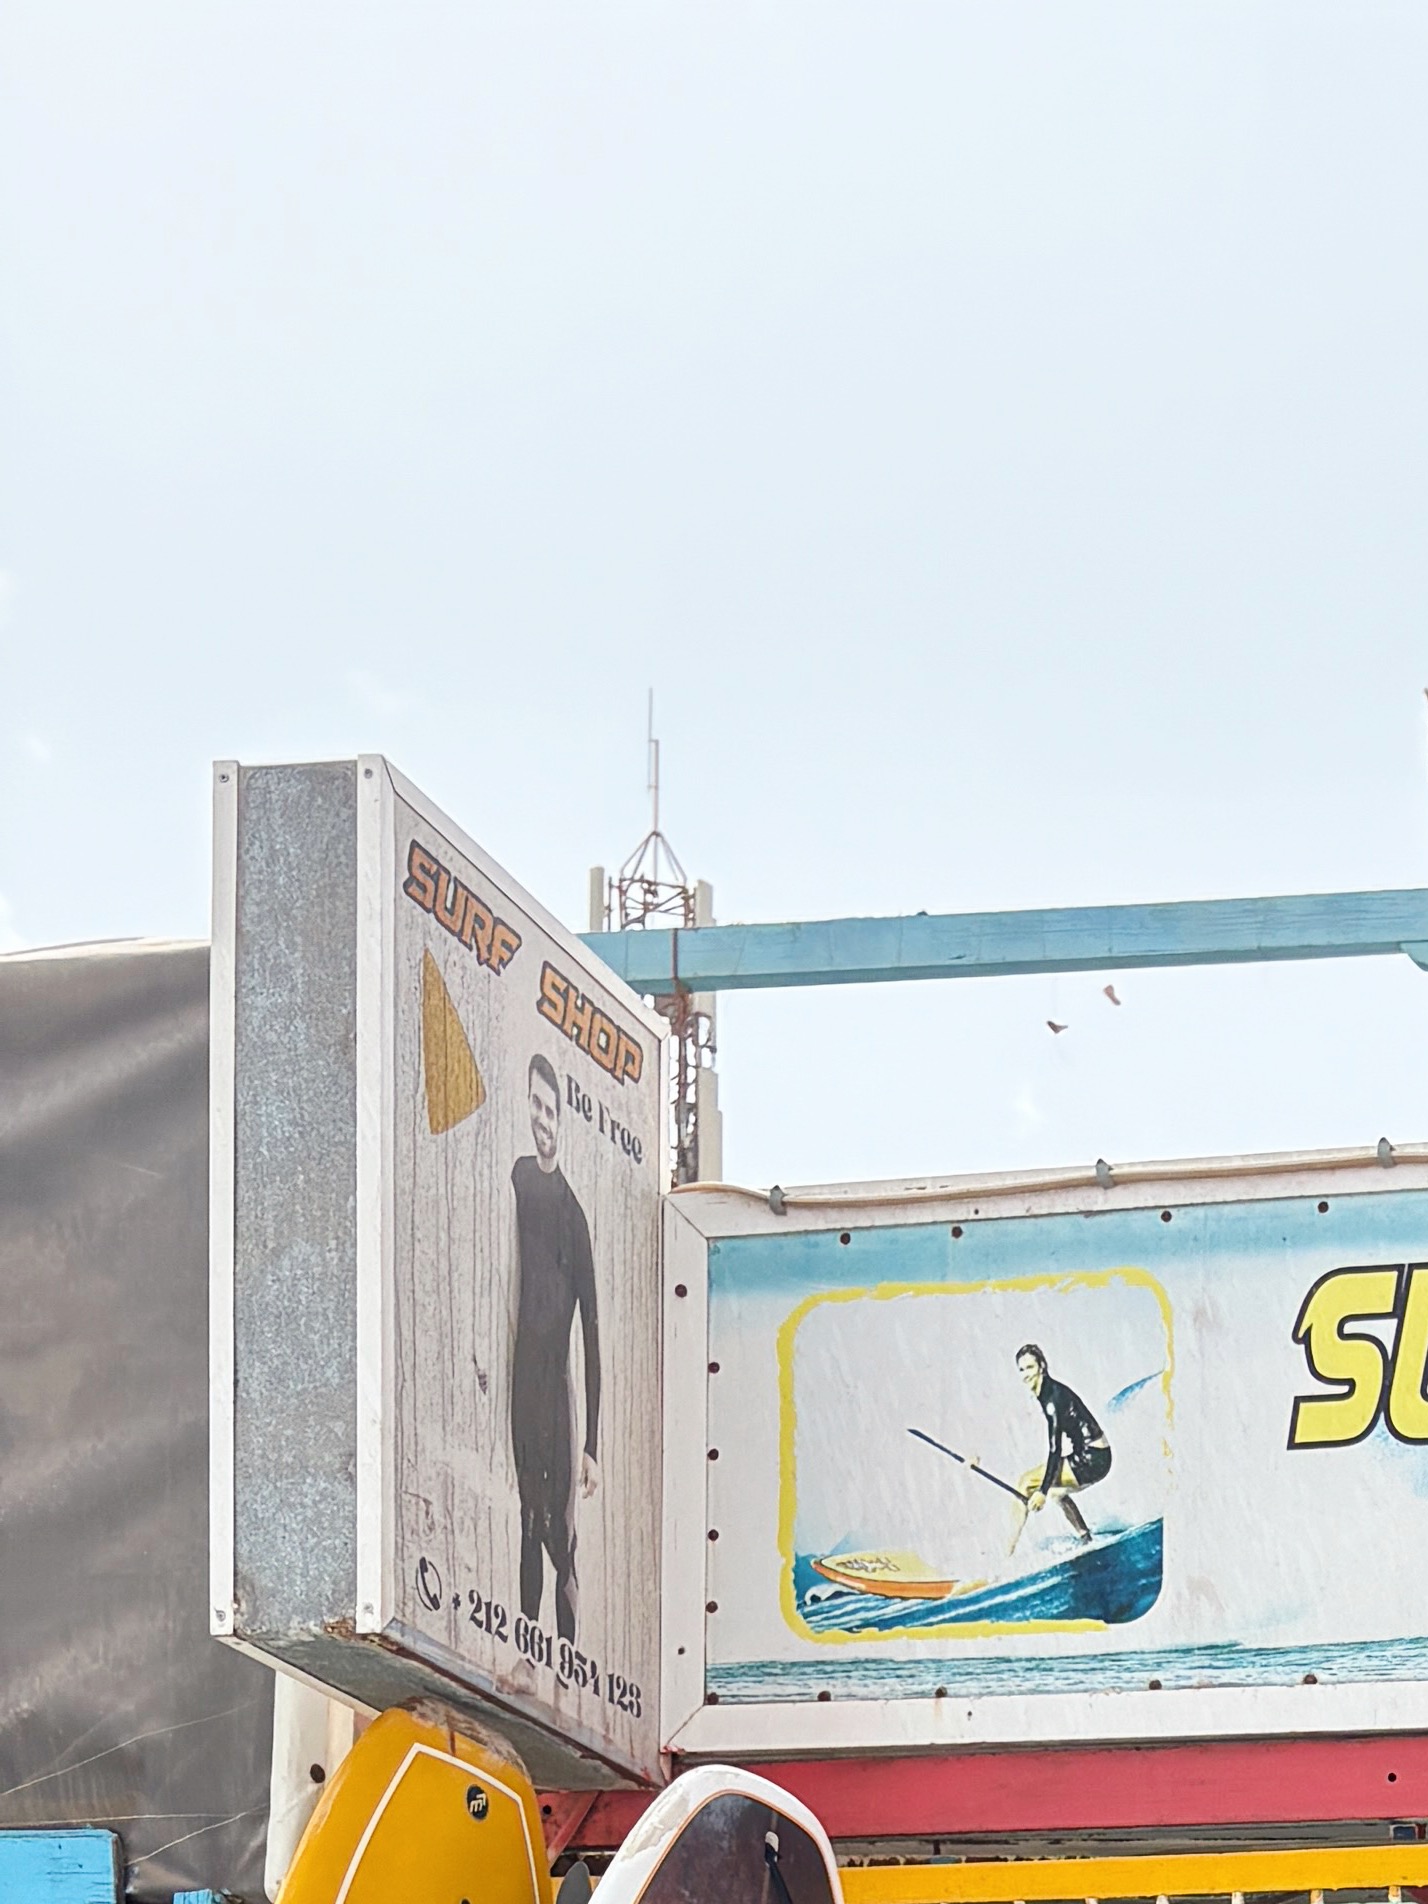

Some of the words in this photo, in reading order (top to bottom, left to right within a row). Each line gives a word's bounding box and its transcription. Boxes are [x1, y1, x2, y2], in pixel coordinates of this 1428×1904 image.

[403, 838, 522, 976] SURF
[536, 960, 643, 1086] SHOP
[566, 1073, 593, 1123] Be
[598, 1099, 643, 1165] Free
[468, 1589, 508, 1643] 212
[515, 1617, 553, 1670] 661
[557, 1643, 600, 1697] 954
[606, 1673, 642, 1719] 123
